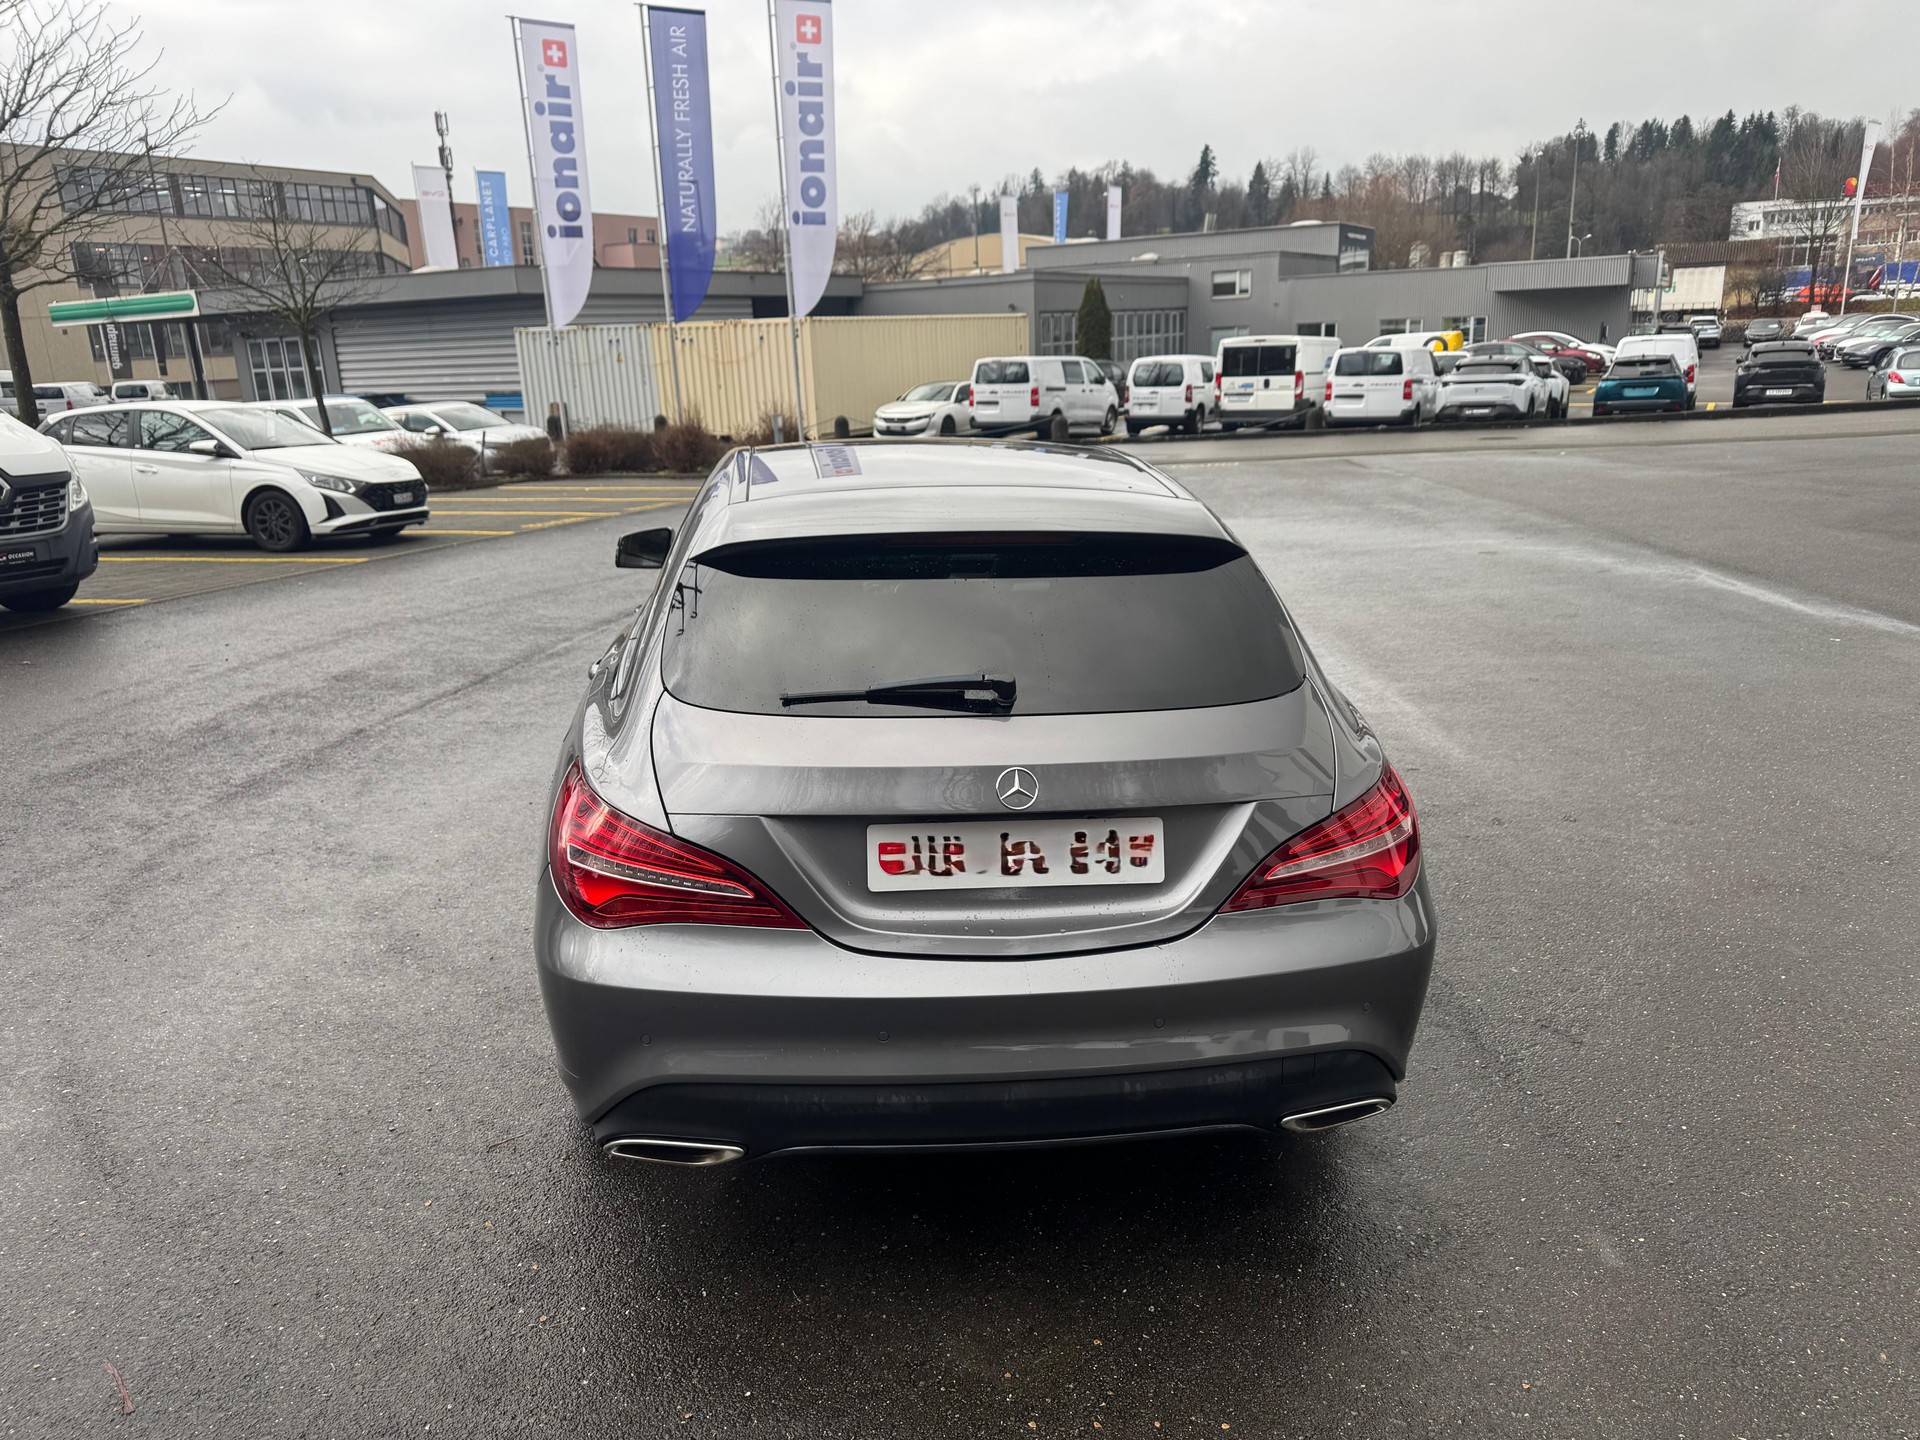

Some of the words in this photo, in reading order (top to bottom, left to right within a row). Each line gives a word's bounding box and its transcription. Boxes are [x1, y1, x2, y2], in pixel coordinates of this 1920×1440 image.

[669, 25, 687, 57] AIR
[671, 63, 691, 122] FRESH
[534, 73, 583, 238] ionair
[675, 127, 697, 233] NATURALLY
[784, 52, 826, 226] ionair
[481, 181, 499, 257] CARPLANET
